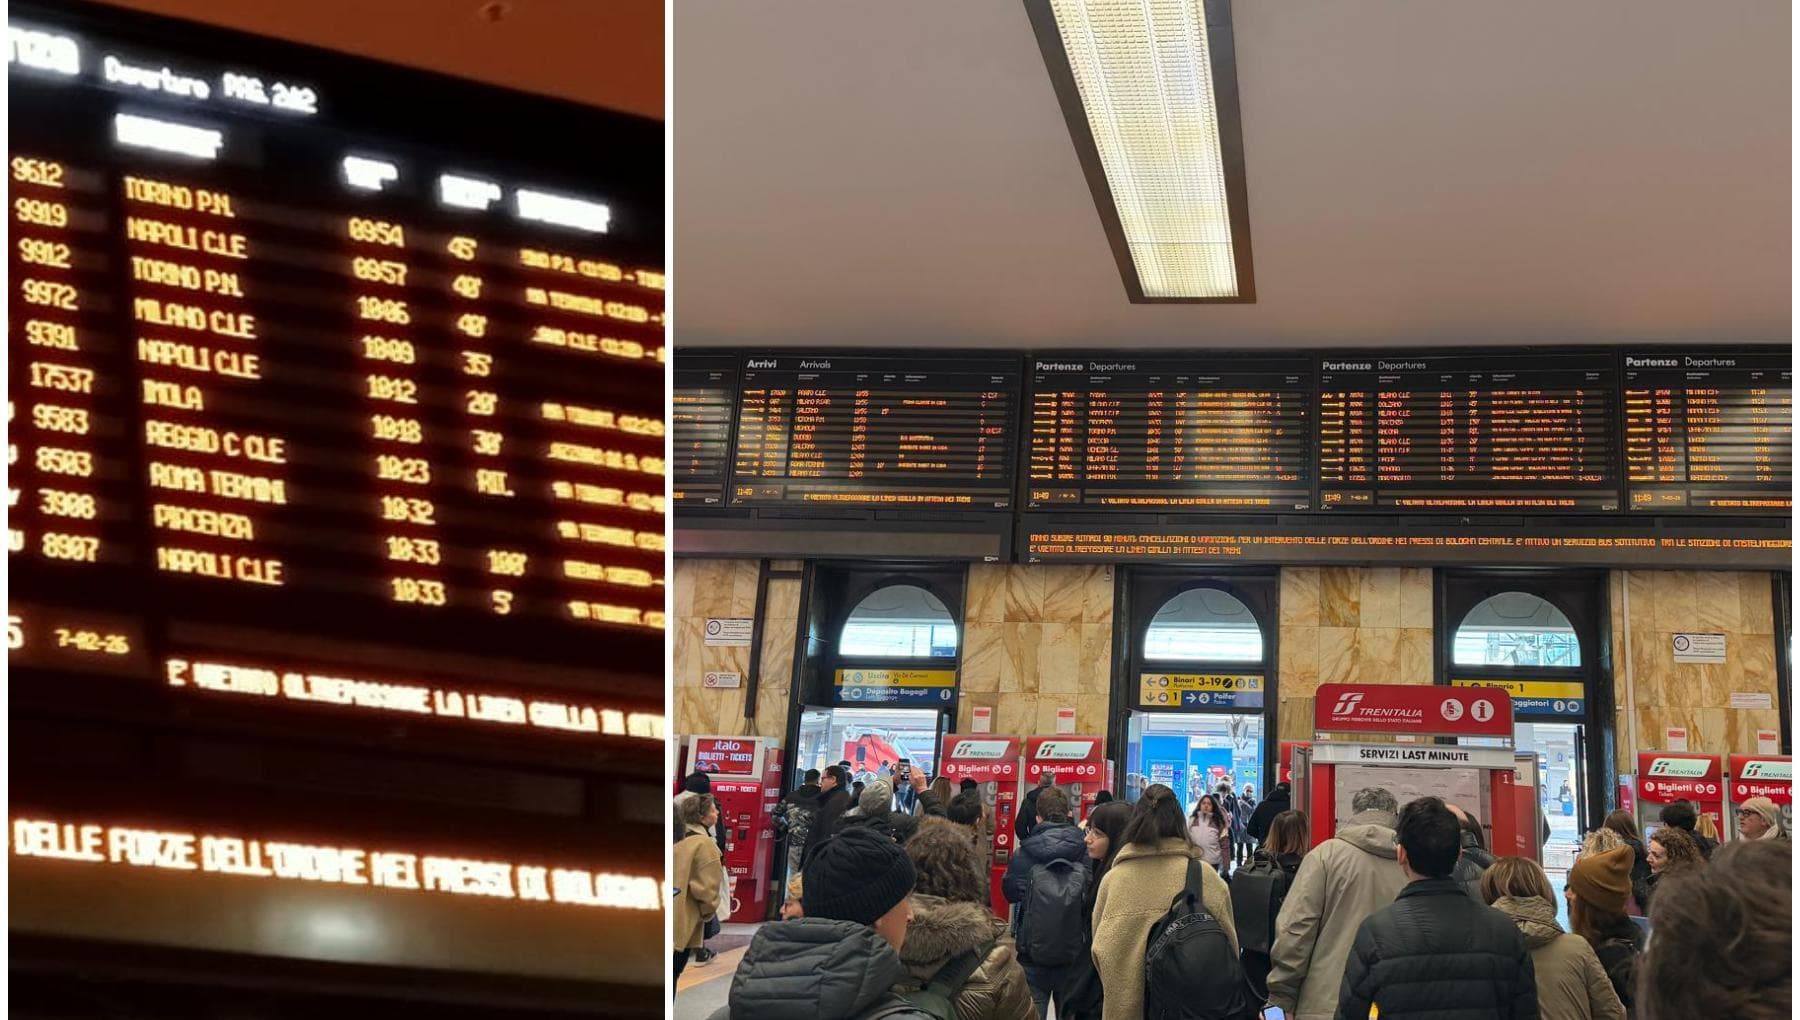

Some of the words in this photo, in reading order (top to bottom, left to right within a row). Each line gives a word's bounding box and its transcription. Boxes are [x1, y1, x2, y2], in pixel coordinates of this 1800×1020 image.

[124, 176, 192, 210] TORINO
[15, 198, 68, 227] 9919
[127, 217, 198, 250] NAPOLI
[18, 237, 71, 268] 9912
[132, 256, 201, 289] TORINO
[22, 279, 78, 311] 9972
[135, 297, 206, 330] MILANO
[138, 338, 210, 371] NAPOLI
[747, 359, 777, 369] Arrivi
[799, 360, 831, 369] Arrivals
[1036, 362, 1083, 371] Partenze
[1089, 362, 1136, 373] Departures
[1322, 362, 1372, 371] Partenze
[1378, 361, 1427, 372] Departures
[1626, 357, 1678, 367] Partenze
[1685, 357, 1736, 368] Departures
[30, 361, 94, 393] 17537
[142, 379, 203, 411] IMOLA
[145, 420, 219, 453] REGGIO
[150, 462, 206, 492] ROMA
[211, 470, 287, 504] TERMINI
[153, 504, 254, 540] PIACENZA
[1305, 536, 1326, 544] DELLE
[1598, 538, 1612, 546] BUS
[157, 547, 232, 579] NAPOLI
[867, 672, 890, 680] Uscita
[1198, 677, 1221, 686] 3-19
[866, 688, 898, 696] Deposito
[899, 689, 928, 697] Bagagli
[1519, 684, 1524, 692] 1
[1174, 692, 1178, 701] 1
[434, 690, 464, 716] LA
[1359, 707, 1423, 717] TRENITALIA
[698, 752, 725, 761] BIGLIETTI
[730, 753, 753, 762] TICKETS
[1360, 749, 1399, 759] SERVIZI
[1402, 750, 1426, 760] LAST
[1428, 750, 1469, 761] MINUTE
[958, 765, 990, 774] Biglietti
[1043, 766, 1074, 774] Biglietti
[1503, 774, 1508, 783] 1
[1657, 782, 1692, 792] Biglietti
[1750, 786, 1785, 796] Biglietti
[13, 820, 105, 861] DELLE
[109, 827, 198, 869] FORZE
[201, 836, 368, 884] DELL'ORDINE
[371, 852, 419, 889] NEI
